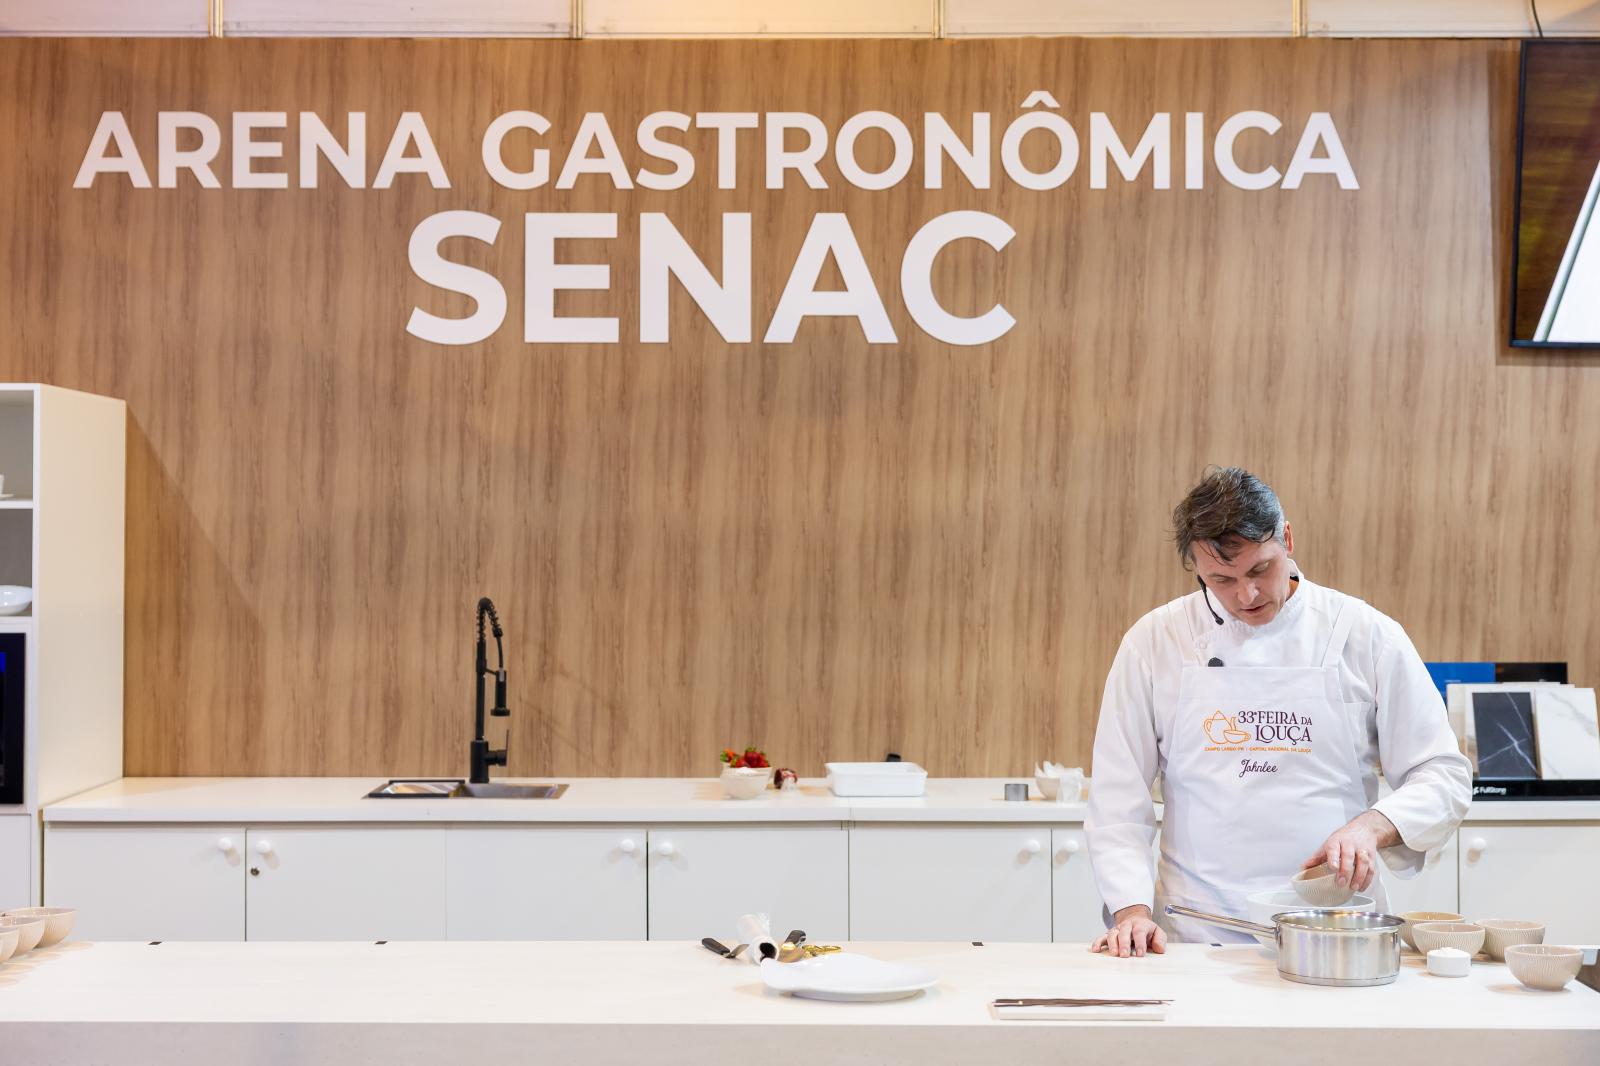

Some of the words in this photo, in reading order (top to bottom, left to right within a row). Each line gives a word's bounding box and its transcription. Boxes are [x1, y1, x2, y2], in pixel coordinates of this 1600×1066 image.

[73, 111, 451, 190] ARENA
[481, 90, 1361, 191] GASTRONÔMICA
[406, 209, 1018, 346] SENAC
[1255, 725, 1312, 745] LOUÇA
[1258, 711, 1298, 725] FEIRA
[1301, 717, 1312, 725] DA
